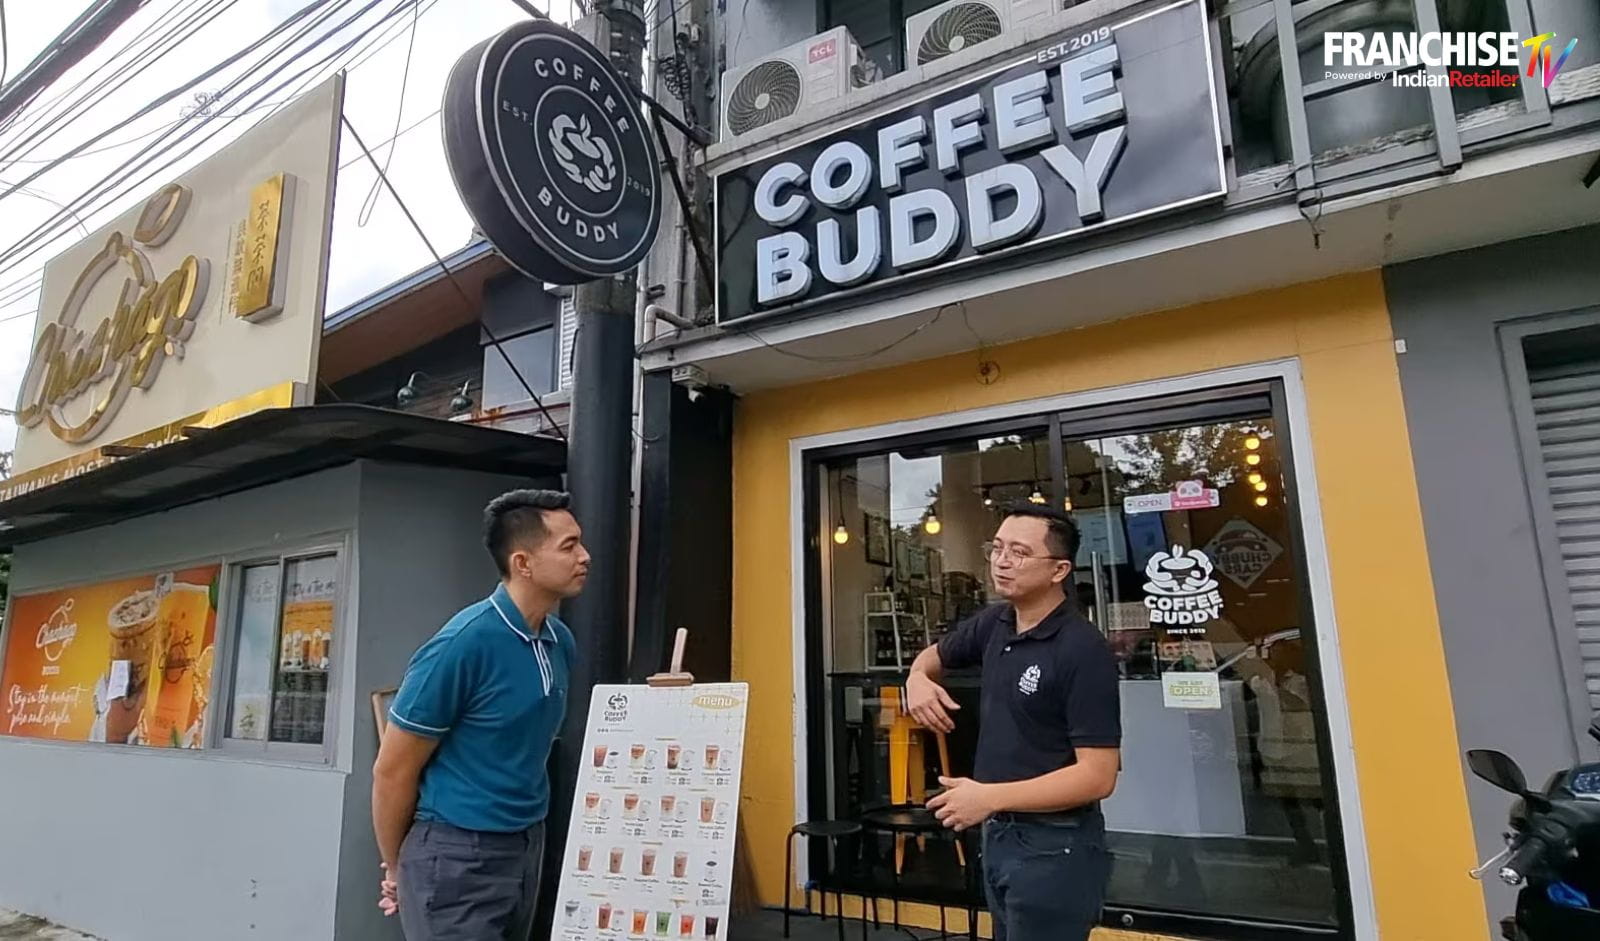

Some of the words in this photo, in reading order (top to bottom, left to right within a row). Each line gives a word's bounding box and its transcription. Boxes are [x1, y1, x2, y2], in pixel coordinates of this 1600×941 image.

[811, 44, 834, 58] TCL
[1036, 46, 1070, 64] EST.
[1070, 26, 1111, 50] 2019
[534, 57, 630, 133] COFFEE
[502, 100, 533, 126] EST.
[754, 43, 1127, 229] COFFEE
[537, 186, 619, 242] BUDDY
[757, 125, 1127, 304] BUDDY
[1144, 590, 1223, 611] COFFEE
[1149, 605, 1219, 625] BUDDY
[699, 695, 732, 706] menu
[1173, 687, 1209, 695] OPEN
